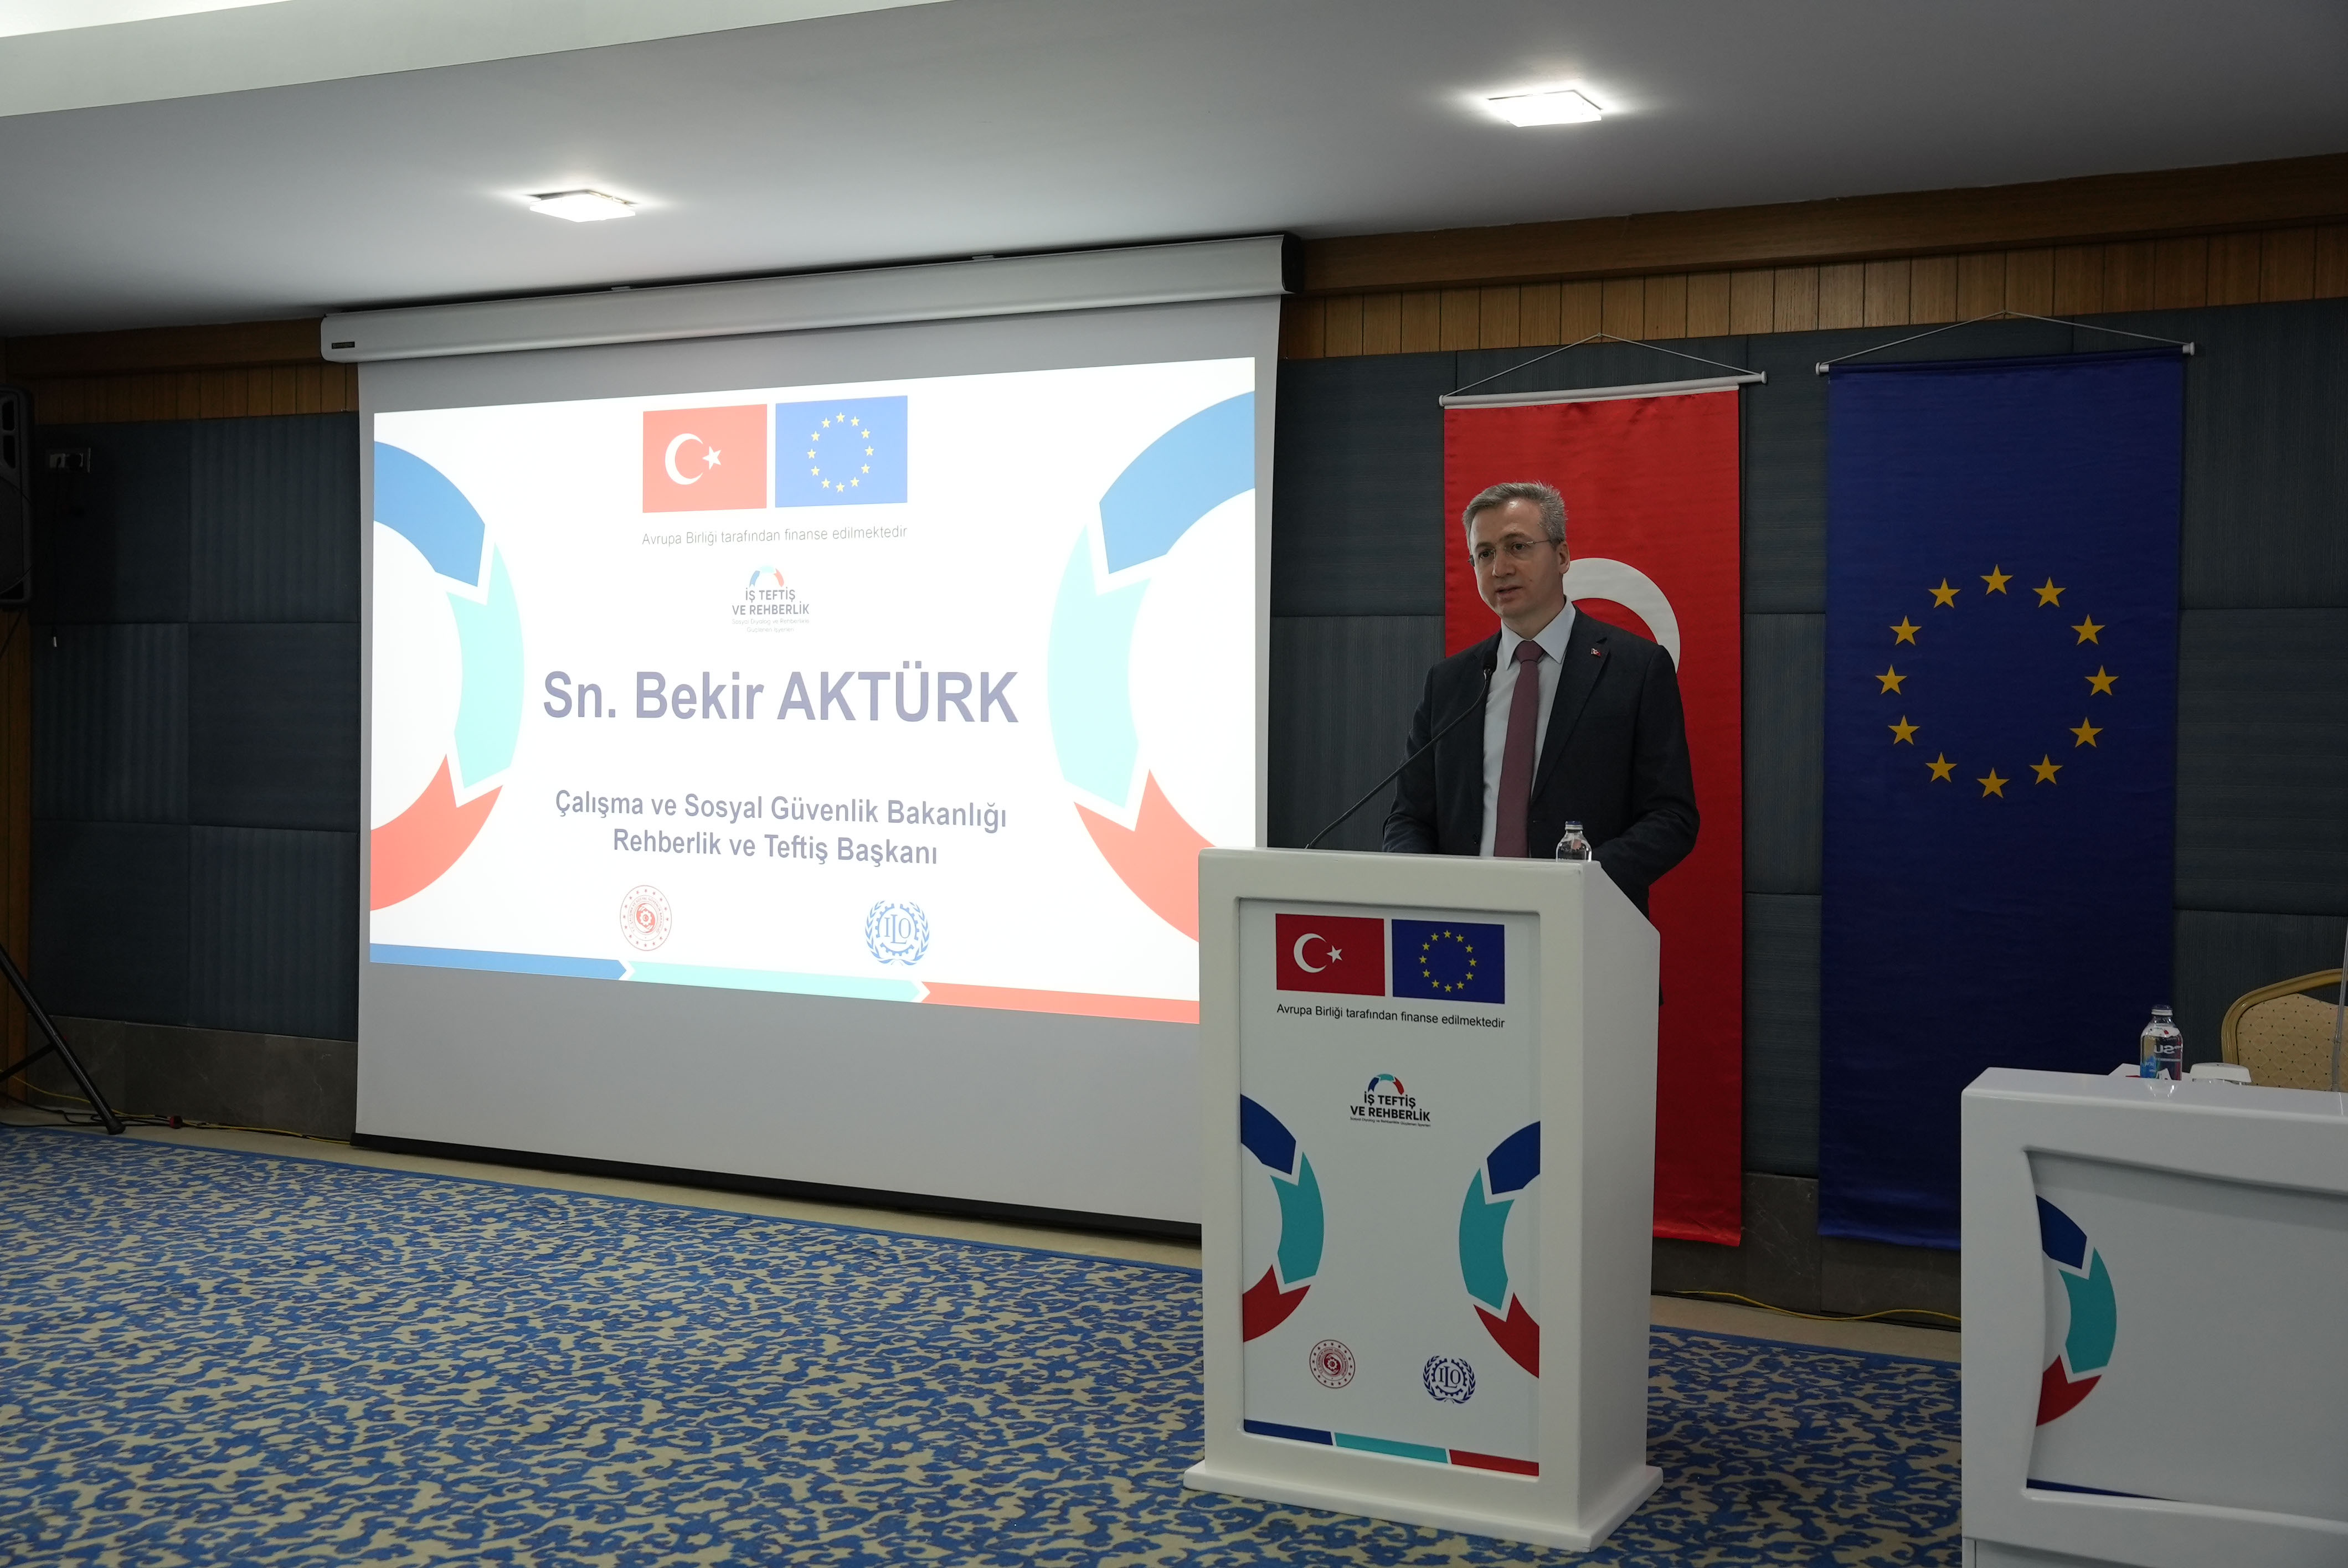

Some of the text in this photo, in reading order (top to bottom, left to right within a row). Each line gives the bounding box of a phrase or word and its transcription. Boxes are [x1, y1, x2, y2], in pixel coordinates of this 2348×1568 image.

[642, 525, 907, 546] Avrupa Birliği tarafından finanse edilmektedir
[745, 587, 796, 602] İŞ TEFTİŞ
[732, 601, 810, 615] VE REHBERLİK
[544, 661, 1019, 723] Sn. Bekir AKTÜRK
[556, 790, 1006, 834] Çalışma ve Sosyal Güvenlik Bakanlığı
[614, 828, 937, 868] Rehberlik ve Teftiş Başkanı
[884, 914, 912, 945] ILO
[1277, 1003, 1506, 1028] Avrupa Birliği tarafından finanse edilmektedir
[1364, 1091, 1416, 1108] İŞ TEFTİŞ
[1350, 1105, 1431, 1122] VE REHBERLİK
[1439, 1365, 1462, 1389] ILO
